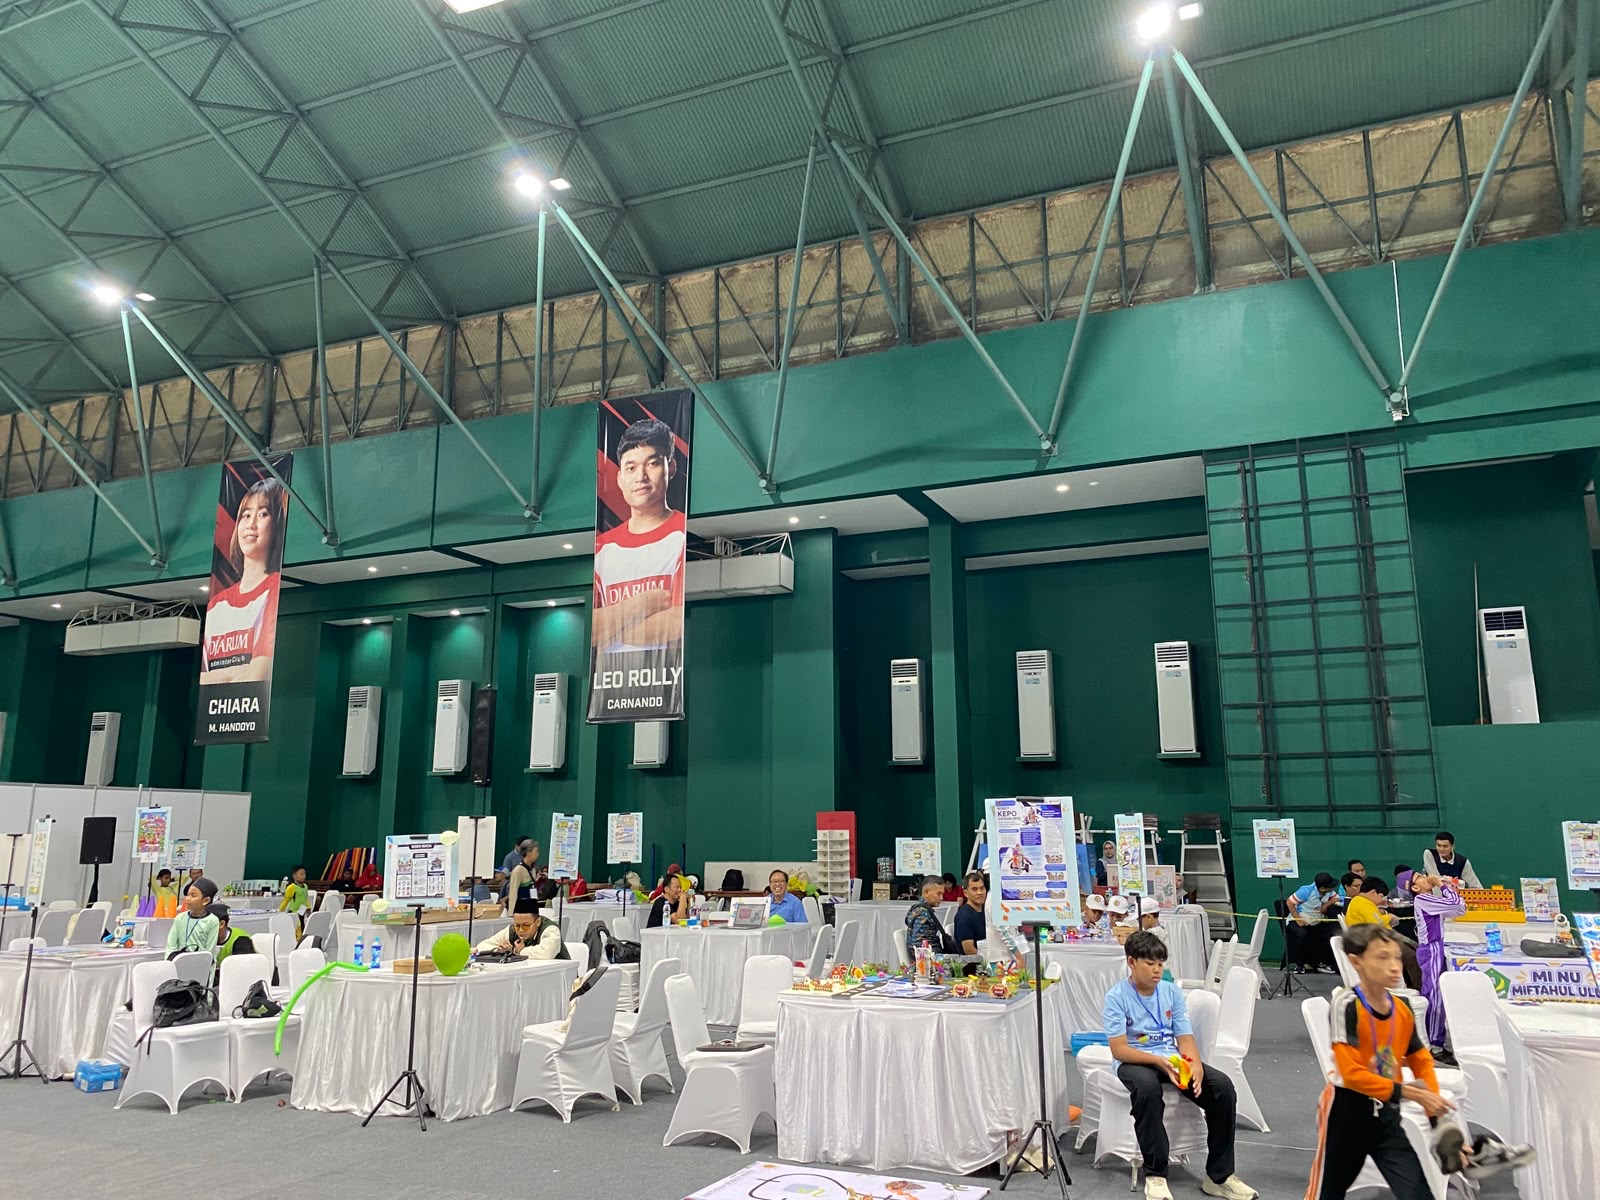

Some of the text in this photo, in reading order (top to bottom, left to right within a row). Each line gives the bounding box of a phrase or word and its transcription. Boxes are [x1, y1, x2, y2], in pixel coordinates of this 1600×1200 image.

[209, 634, 248, 656] DJARUM
[593, 667, 683, 690] LEO ROLLY
[208, 697, 260, 715] CHIARA
[607, 696, 663, 710] CARNANDO
[208, 721, 256, 733] M. HANDOYO
[1532, 970, 1581, 983] MI NU
[1512, 985, 1576, 997] MIFTAHUL
